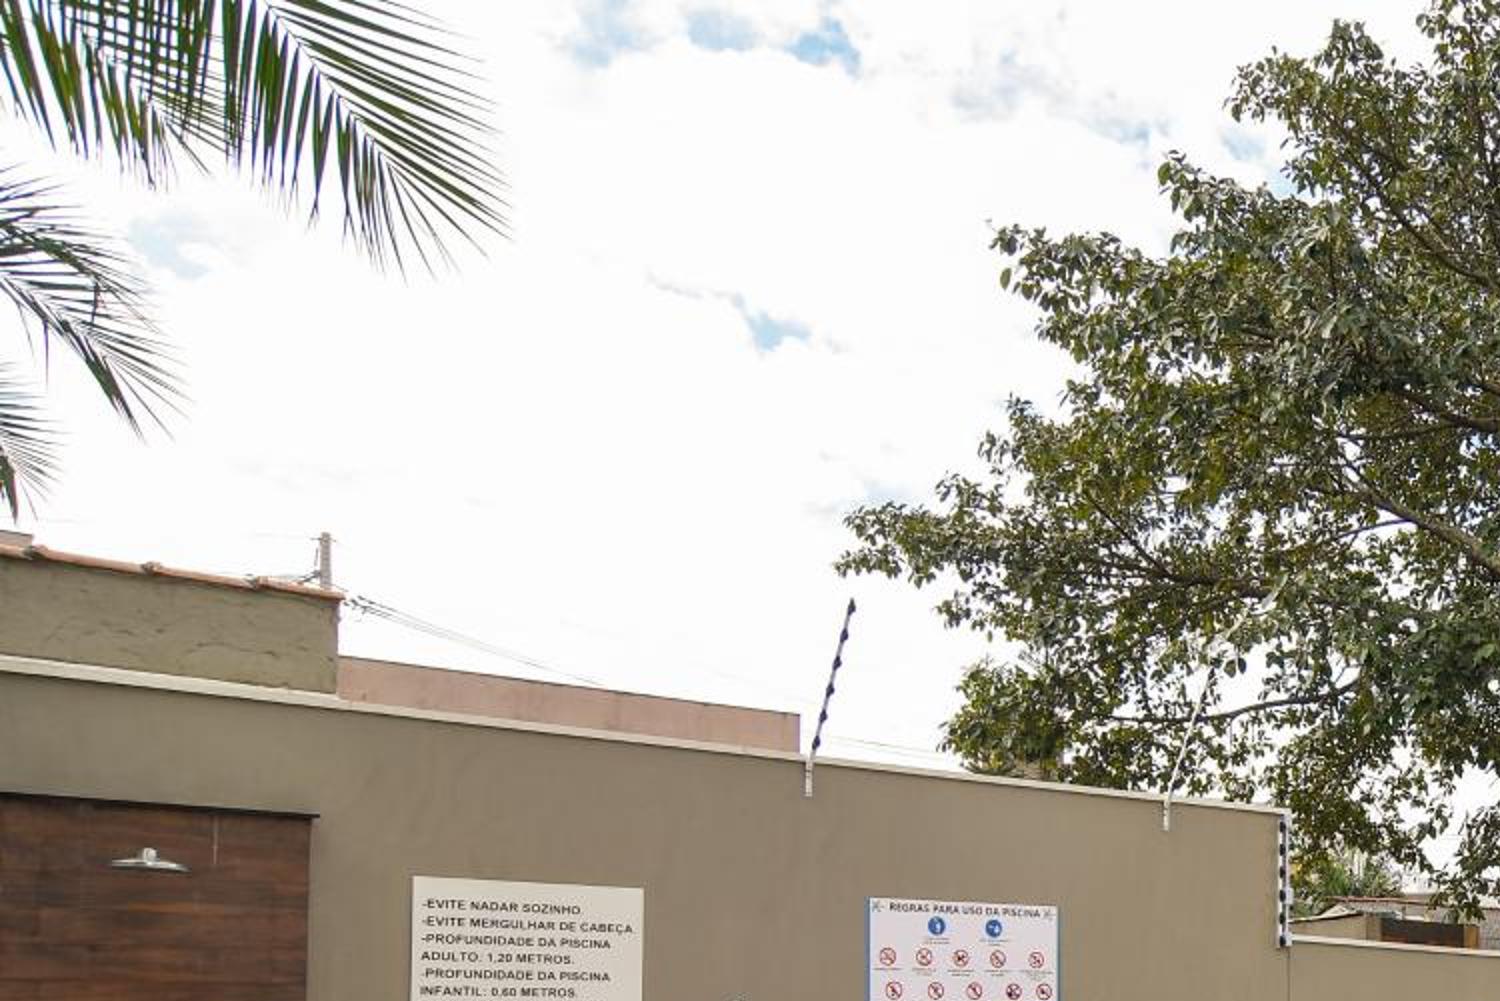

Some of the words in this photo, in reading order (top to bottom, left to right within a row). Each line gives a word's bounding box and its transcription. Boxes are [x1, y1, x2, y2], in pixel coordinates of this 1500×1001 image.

[470, 901, 518, 912] NADAR
[889, 902, 929, 912] REGRAS
[933, 904, 960, 914] PARA
[961, 905, 982, 915] USO
[986, 906, 1000, 915] DA
[1002, 908, 1040, 918] PISCINA
[470, 918, 555, 930] MERGULHAR
[560, 922, 576, 932] DE
[538, 938, 556, 947] DA
[560, 938, 611, 949] PISCINA
[538, 971, 556, 980] DA
[560, 972, 611, 982] PISCINA
